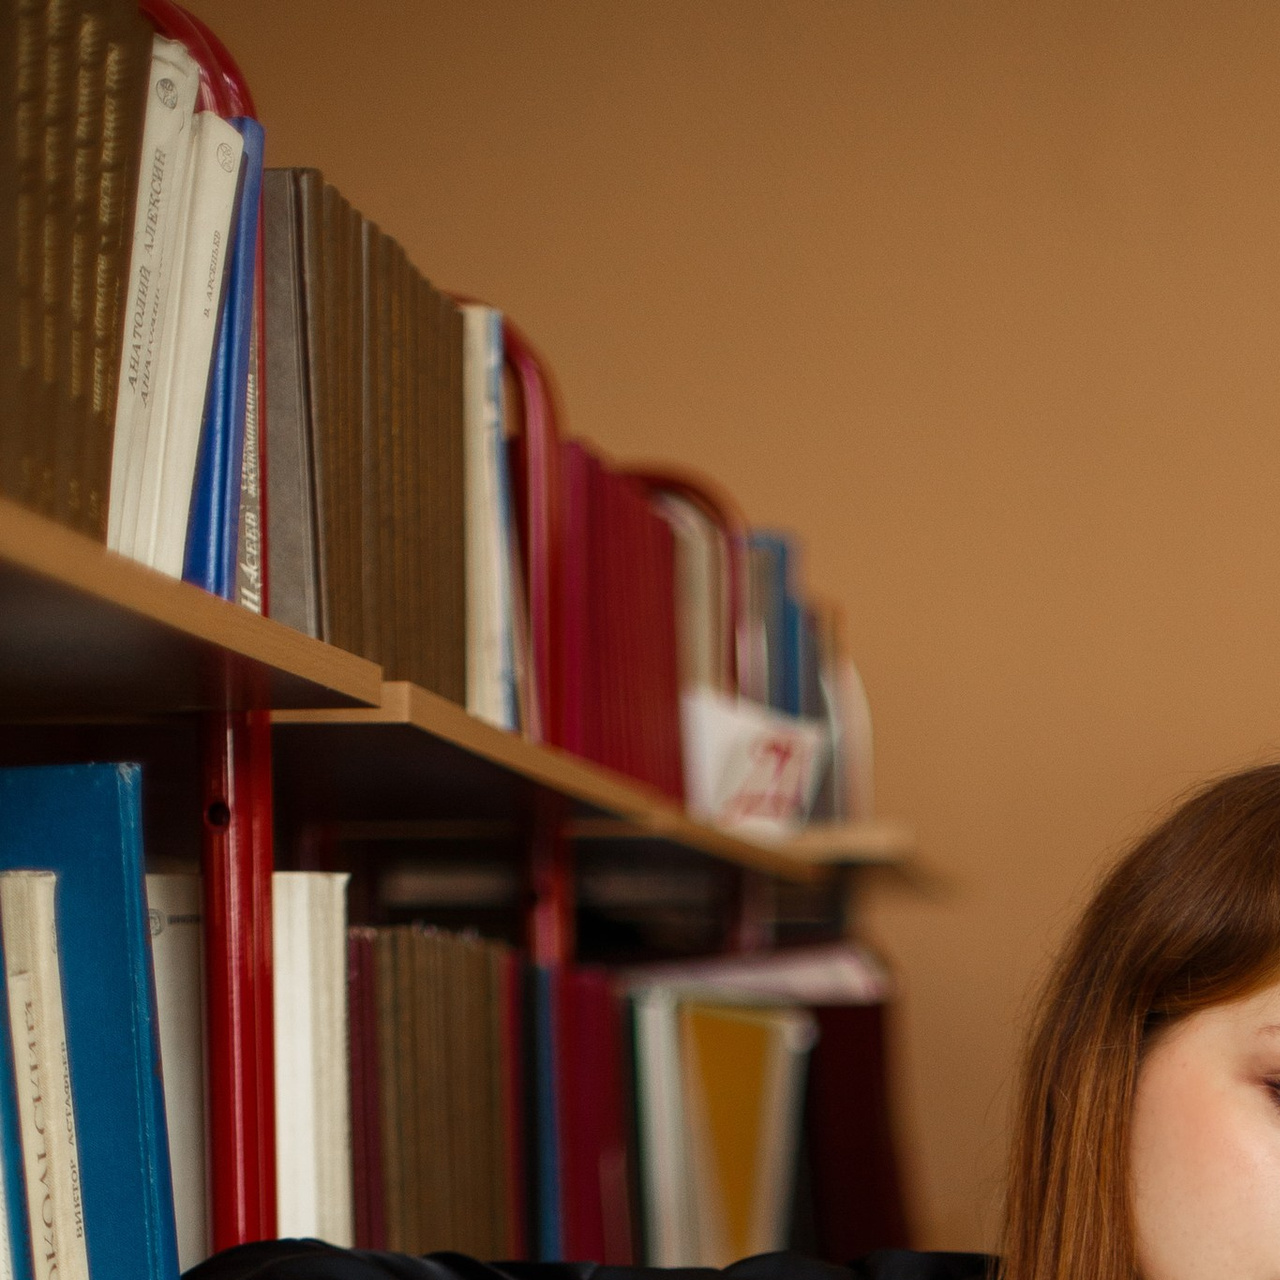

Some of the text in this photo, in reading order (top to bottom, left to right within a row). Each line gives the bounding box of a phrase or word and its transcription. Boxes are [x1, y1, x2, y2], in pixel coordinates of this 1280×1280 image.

[128, 264, 152, 394] АНАТОЛИЙ
[144, 147, 166, 257] АЛЕКСИН
[69, 1159, 83, 1239] ВИКТОР
